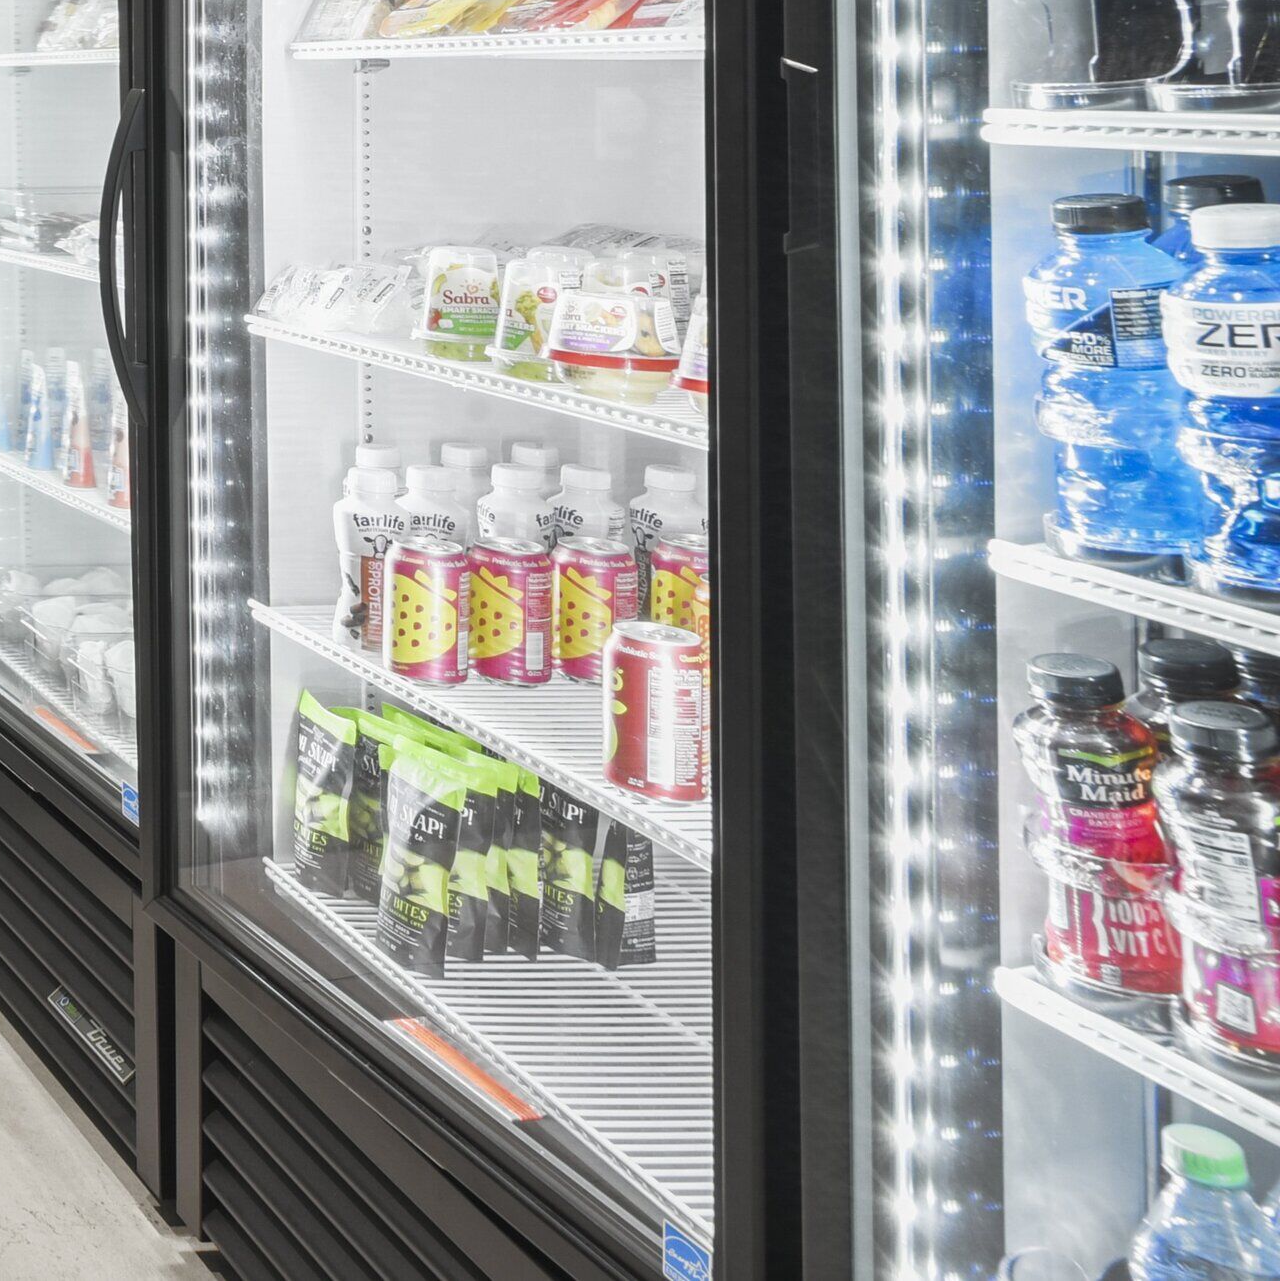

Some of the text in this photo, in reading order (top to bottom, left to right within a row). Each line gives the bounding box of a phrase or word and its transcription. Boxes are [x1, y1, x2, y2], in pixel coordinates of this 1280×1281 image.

[442, 289, 489, 305] Sabra
[1071, 330, 1112, 346] 50%
[1197, 321, 1280, 349] ZER
[1070, 344, 1112, 356] MORE
[1201, 364, 1247, 379] ZERO
[410, 512, 456, 532] airlife
[492, 557, 538, 568] Prebiotic Soda
[1067, 763, 1152, 787] Minute
[1080, 783, 1145, 803] Maid
[400, 802, 448, 840] SNAP!
[393, 897, 430, 922] BITES
[1106, 898, 1159, 926] 100%
[1109, 926, 1167, 958] VIT C
